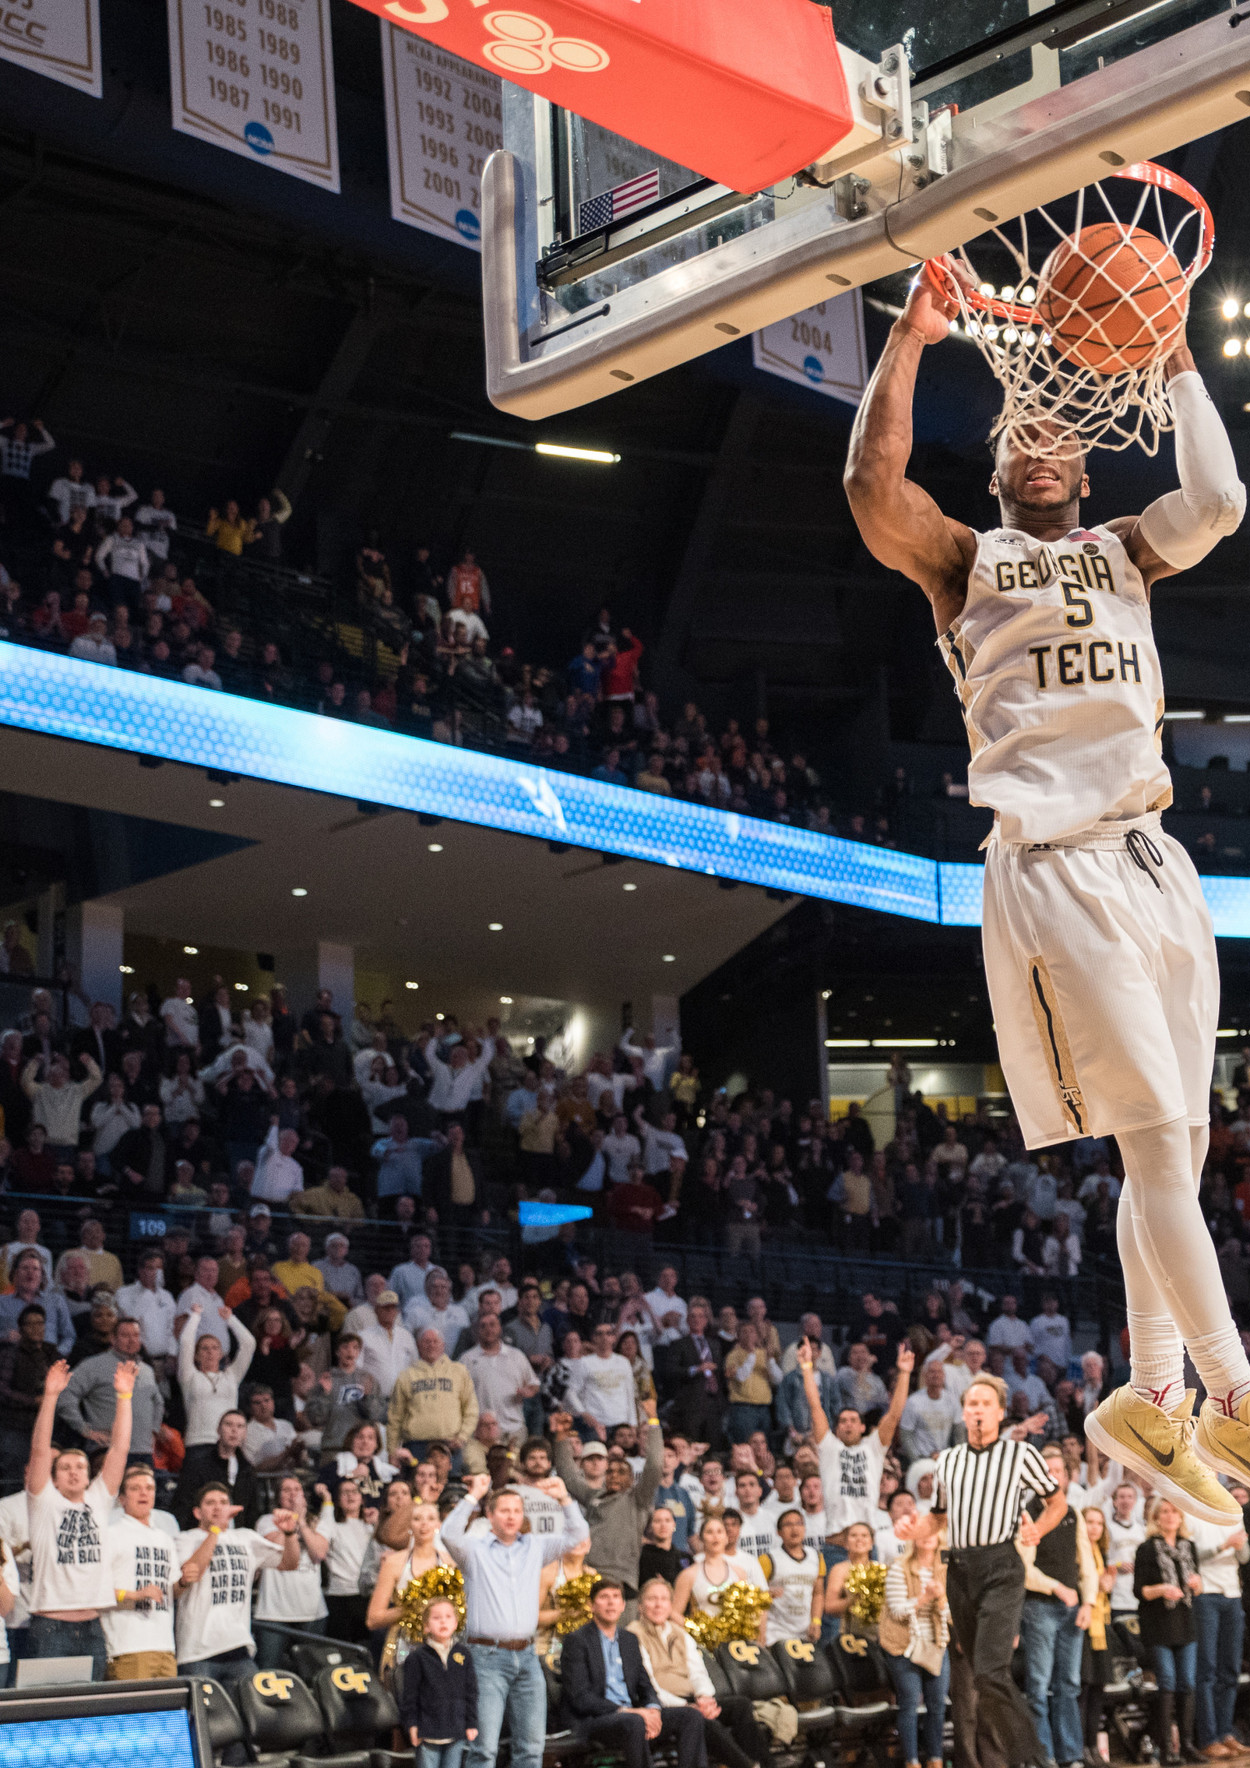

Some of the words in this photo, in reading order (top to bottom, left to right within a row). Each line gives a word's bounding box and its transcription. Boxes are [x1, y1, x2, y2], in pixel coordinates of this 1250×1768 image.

[0, 7, 46, 44] CC
[204, 4, 247, 42] 1985
[259, 27, 300, 65] 1989
[206, 39, 250, 78] 1986
[260, 63, 303, 101] 1990
[415, 66, 451, 102] 1992
[437, 54, 500, 93] APPEARANCE
[208, 74, 250, 111] 1987
[262, 97, 301, 135] 1991
[417, 101, 456, 134] 1993
[421, 133, 459, 168] 1996
[423, 166, 460, 202] 2001
[790, 317, 832, 355] 2004
[1060, 581, 1096, 630] 5
[1028, 640, 1142, 689] TECH
[139, 1219, 166, 1237] 109
[211, 1574, 228, 1588] AIR
[253, 1671, 294, 1699] GT
[331, 1666, 371, 1694] GT
